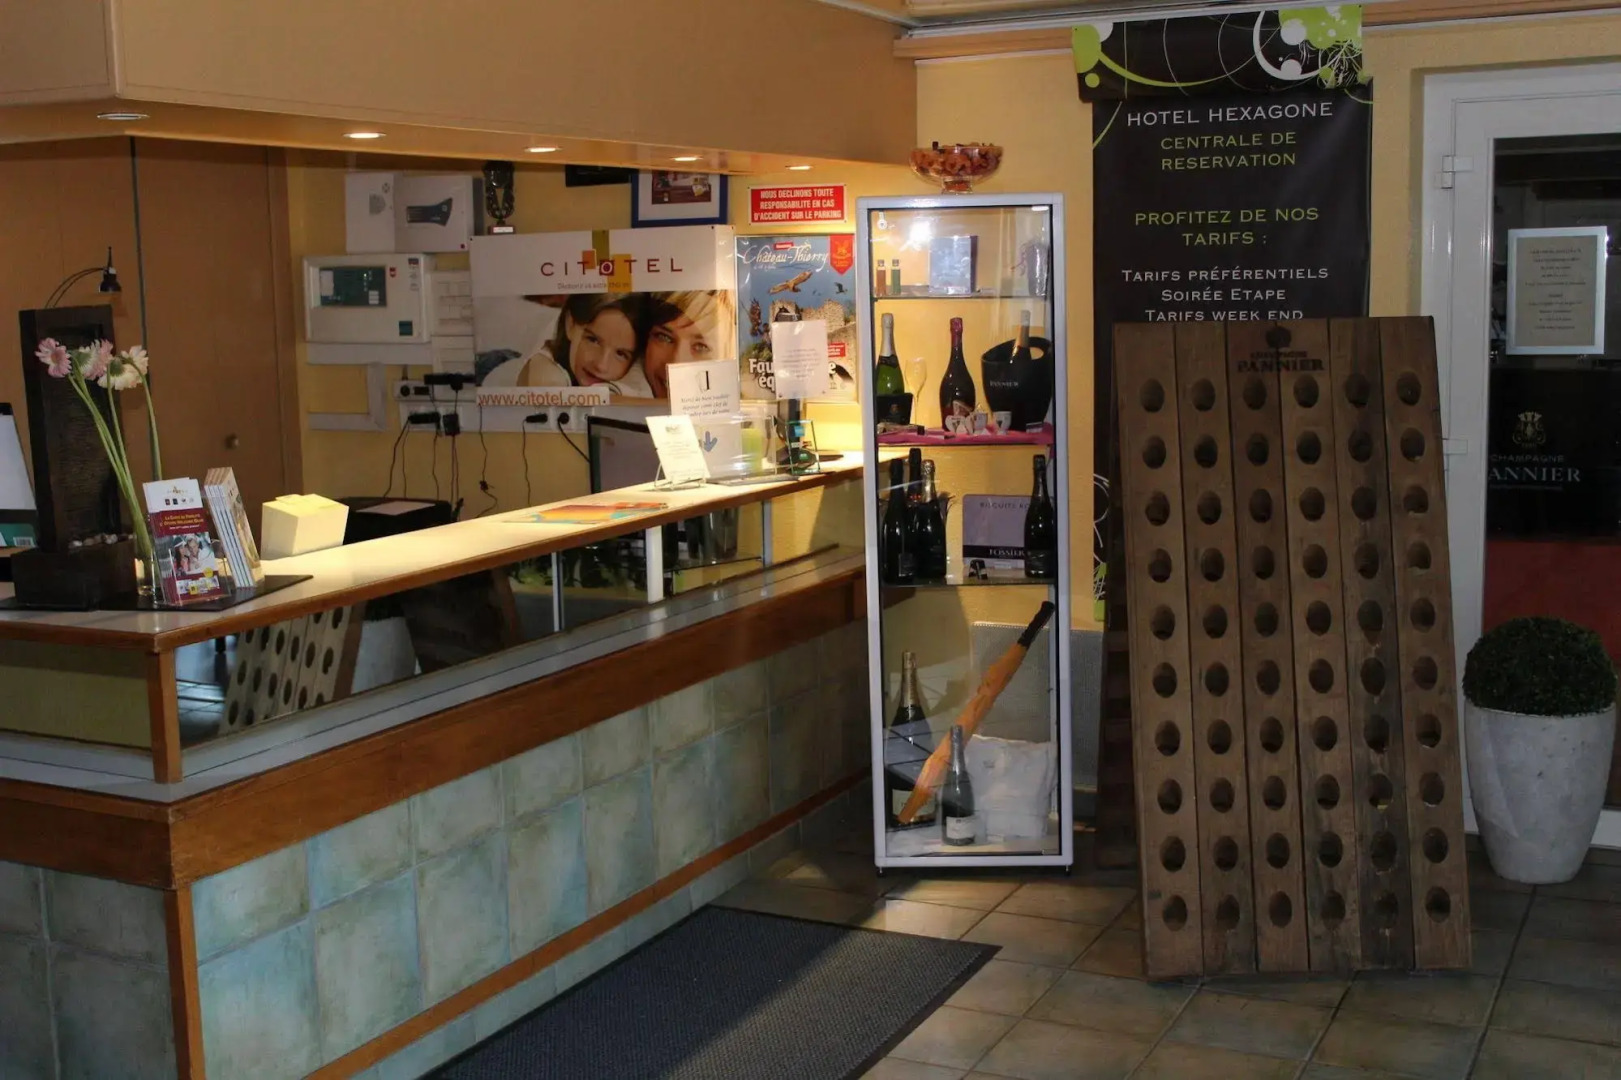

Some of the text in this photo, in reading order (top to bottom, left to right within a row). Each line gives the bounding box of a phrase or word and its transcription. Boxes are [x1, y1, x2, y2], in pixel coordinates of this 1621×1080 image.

[1127, 102, 1333, 127] HOTEL HEXAGONE
[1160, 131, 1297, 150] CENTRALE DE
[1161, 153, 1296, 170] RESERVATION
[760, 188, 834, 199] NOUS DECLINONS TOUTE
[760, 199, 835, 209] RESPONSABILITE EN CAS
[753, 210, 842, 221] D'ACCIDENT SUR LE PARKING
[1135, 207, 1319, 226] PROFITEZ DE NOS
[1182, 231, 1254, 246] TARIFS
[540, 257, 683, 277] CITOTEL
[1121, 266, 1329, 282] TARIFS PRÉFÉRENTIELS
[1161, 287, 1286, 302] SOIRÉE ETAPE
[1145, 309, 1303, 322] TARIFS WEEK END
[478, 391, 601, 406] www.citotel.com
[1490, 454, 1565, 462] CHAMPAGNE
